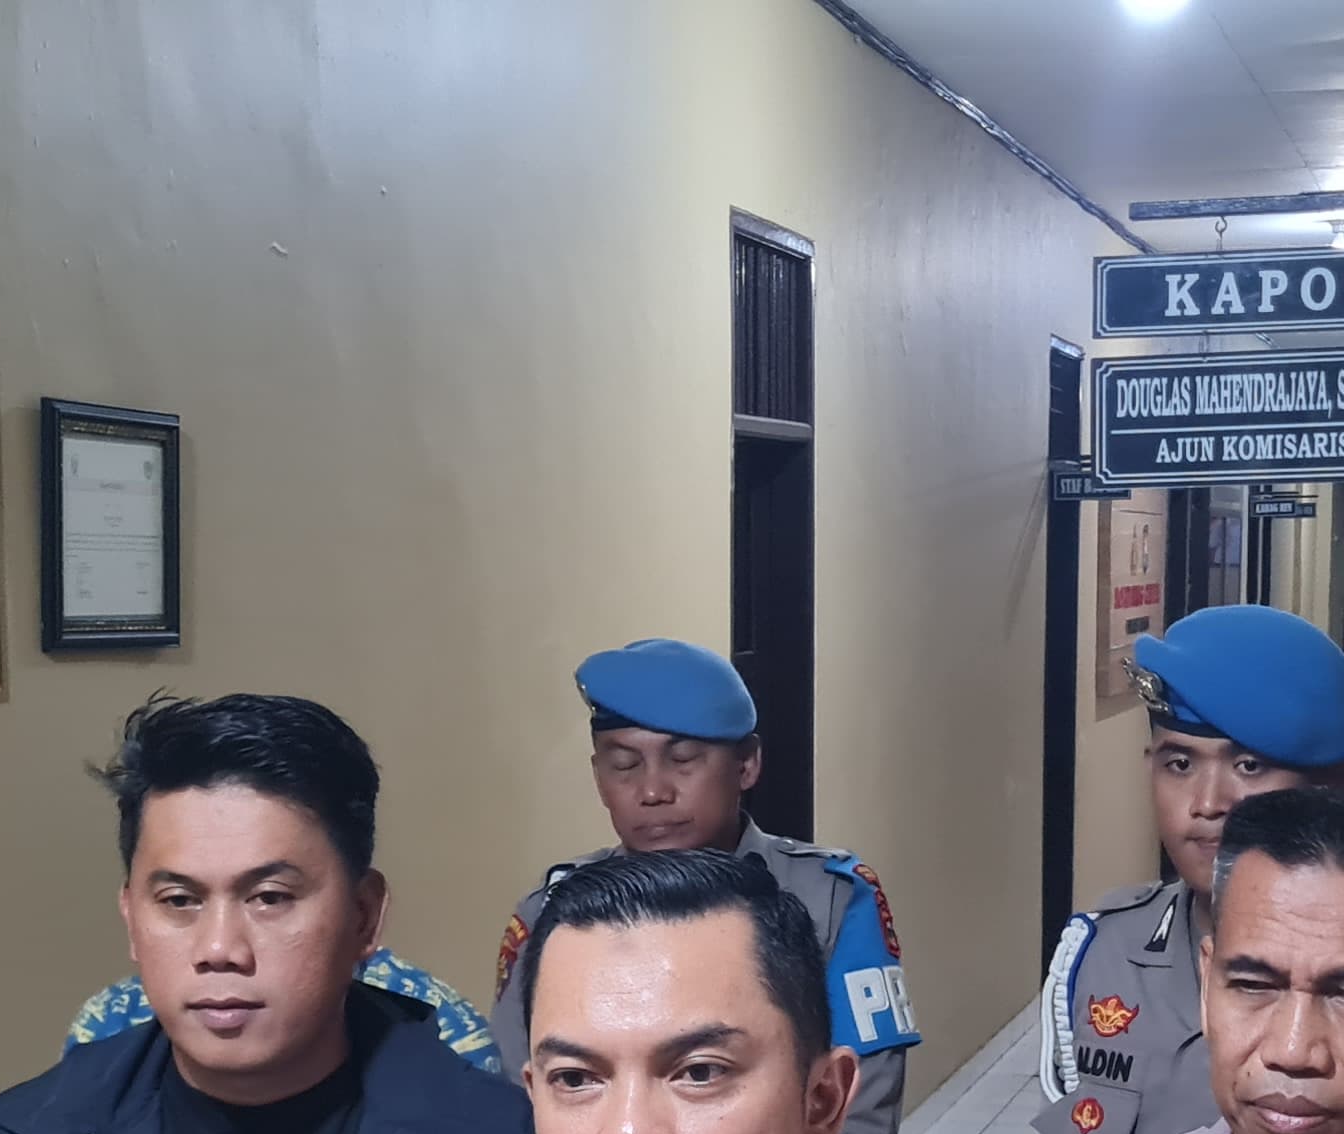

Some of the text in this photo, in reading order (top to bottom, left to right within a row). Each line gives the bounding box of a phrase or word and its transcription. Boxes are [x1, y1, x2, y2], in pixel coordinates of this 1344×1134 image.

[1116, 376, 1191, 419] DOUGLAS
[1195, 371, 1333, 419] MAHENDRAJAYA,
[1156, 436, 1215, 463] AJUN
